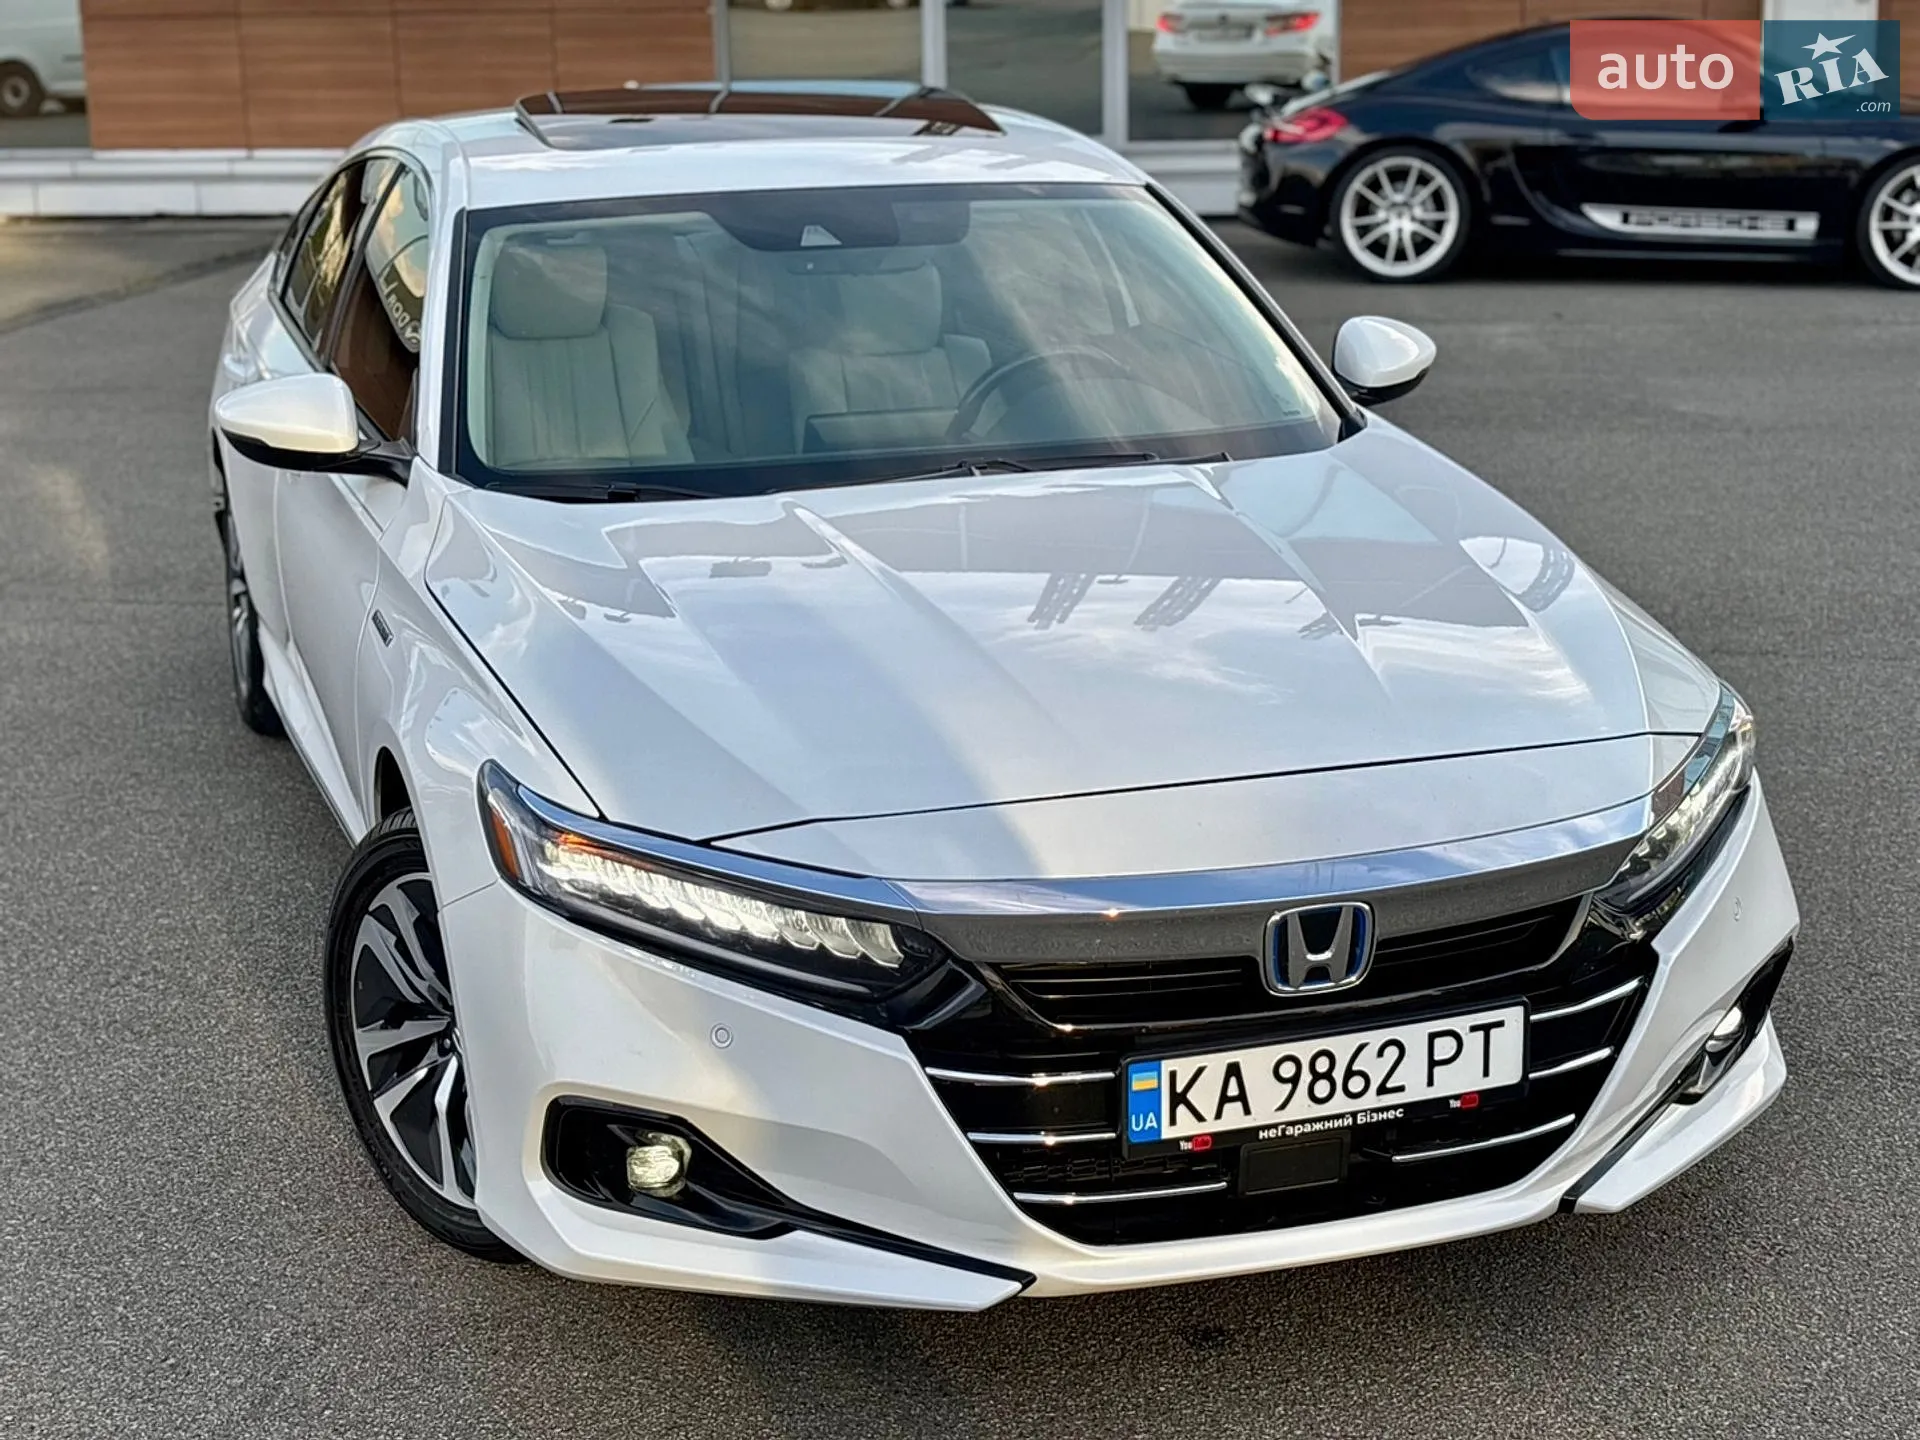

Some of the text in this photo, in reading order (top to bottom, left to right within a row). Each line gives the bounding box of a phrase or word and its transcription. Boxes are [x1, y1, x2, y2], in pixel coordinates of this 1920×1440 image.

[1168, 1020, 1506, 1127] KA 9862 PT
[1132, 1111, 1158, 1132] UA
[1258, 1108, 1405, 1140] неГаражний Бізнес
